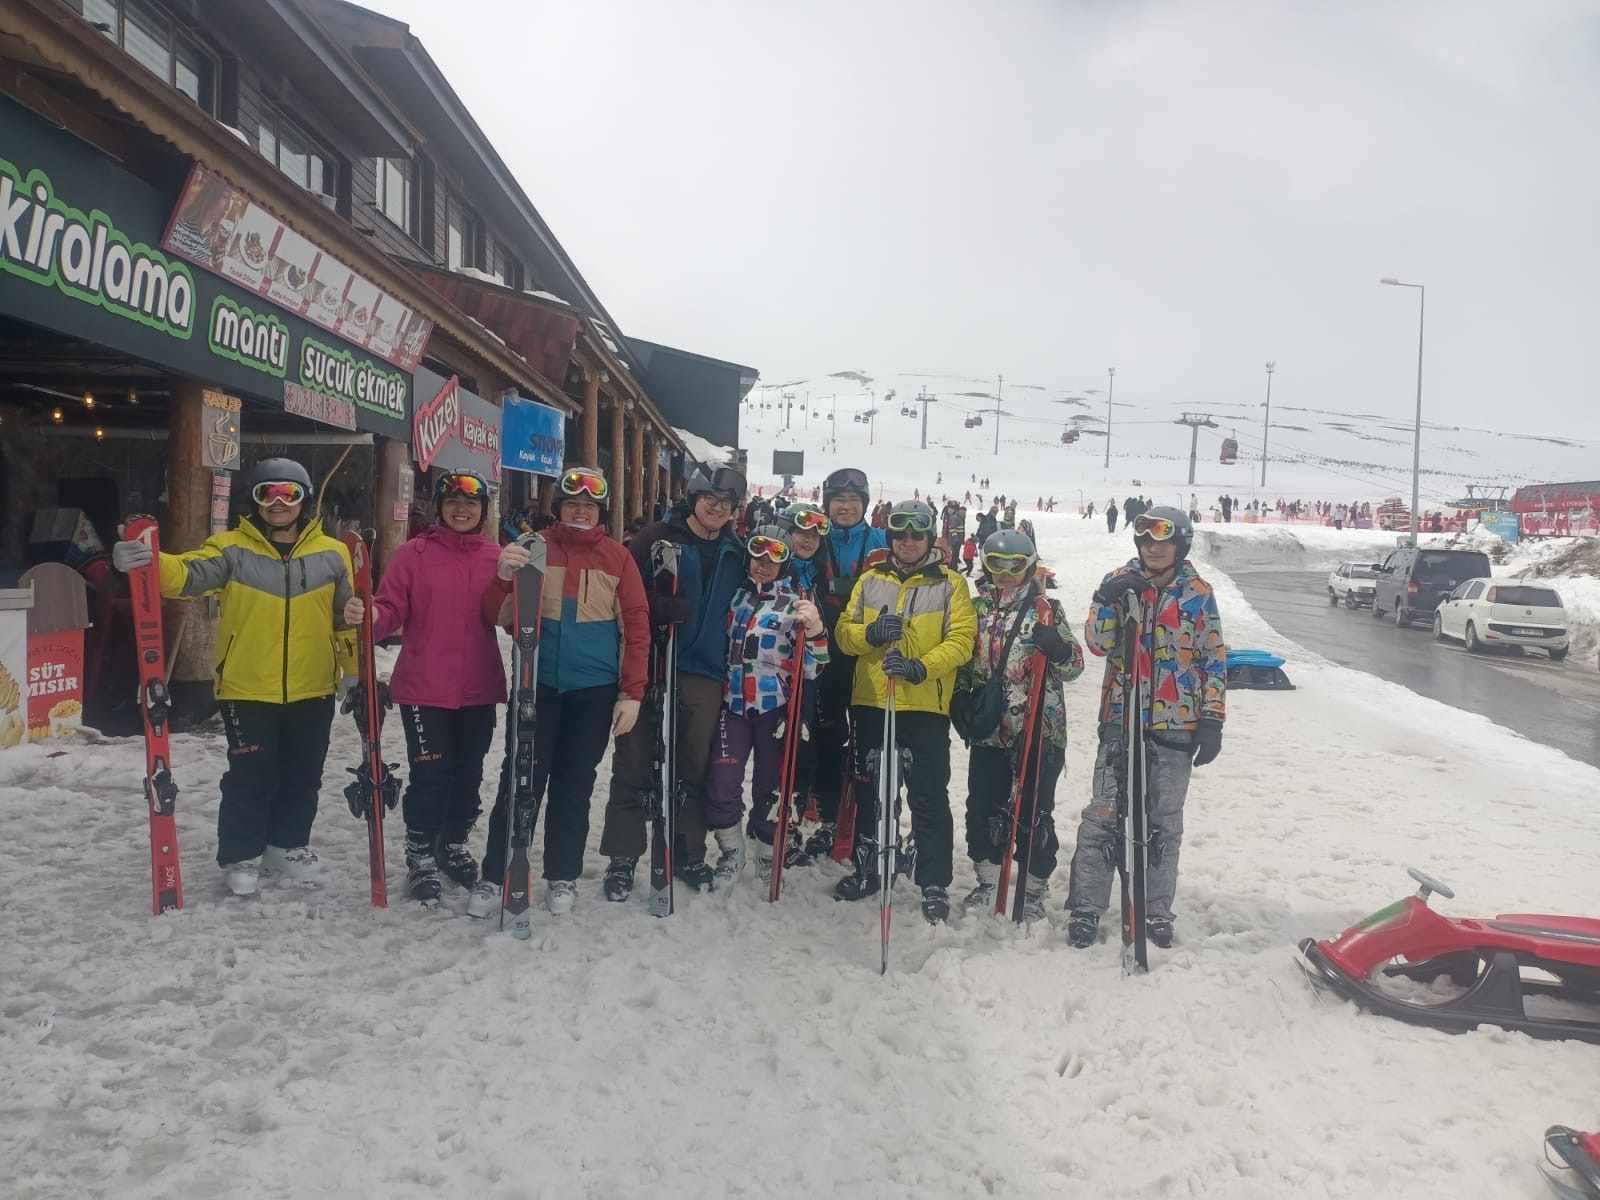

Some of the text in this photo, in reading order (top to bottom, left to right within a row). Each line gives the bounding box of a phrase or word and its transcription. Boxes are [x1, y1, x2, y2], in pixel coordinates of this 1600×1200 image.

[0, 176, 192, 328] kiralama
[304, 346, 355, 396] sucuk
[357, 368, 404, 411] ekmek
[418, 387, 459, 461] Kuzey
[463, 416, 499, 449] kayak evi
[30, 662, 65, 681] SÜT
[166, 866, 175, 888] RACE
